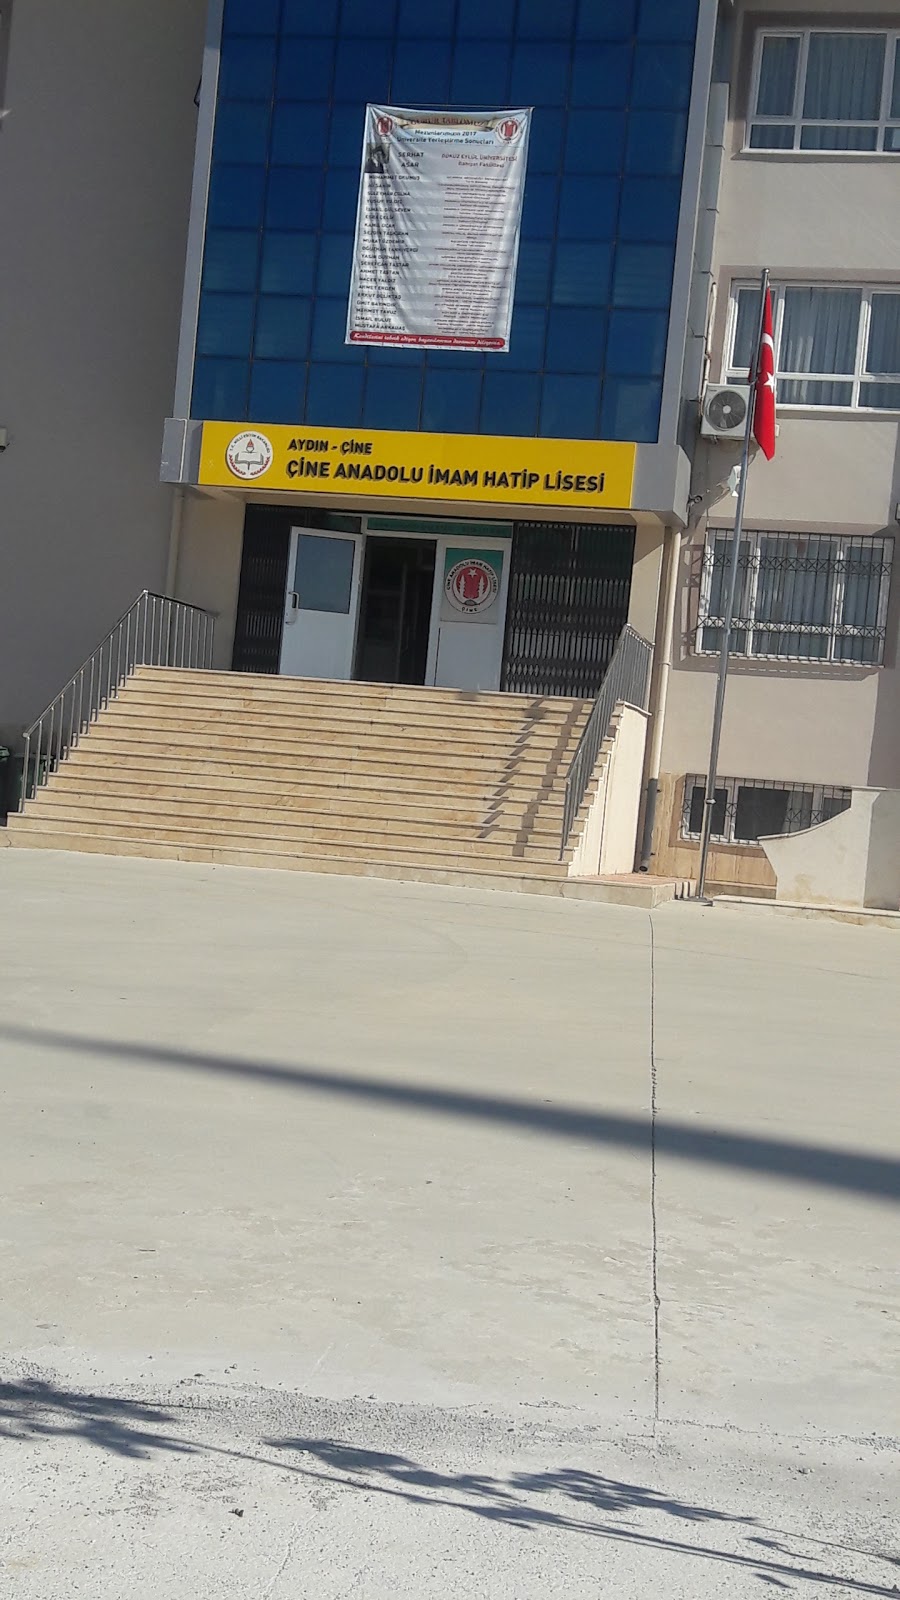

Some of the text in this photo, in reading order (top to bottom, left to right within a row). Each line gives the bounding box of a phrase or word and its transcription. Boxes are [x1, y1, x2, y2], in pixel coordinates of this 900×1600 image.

[287, 439, 328, 452] AYDIN
[340, 440, 373, 455] ÇİNE
[286, 457, 605, 493] ÇİNE ANADOLU İMAM HATİP LİSESİ
[449, 562, 470, 578] ANADOLU
